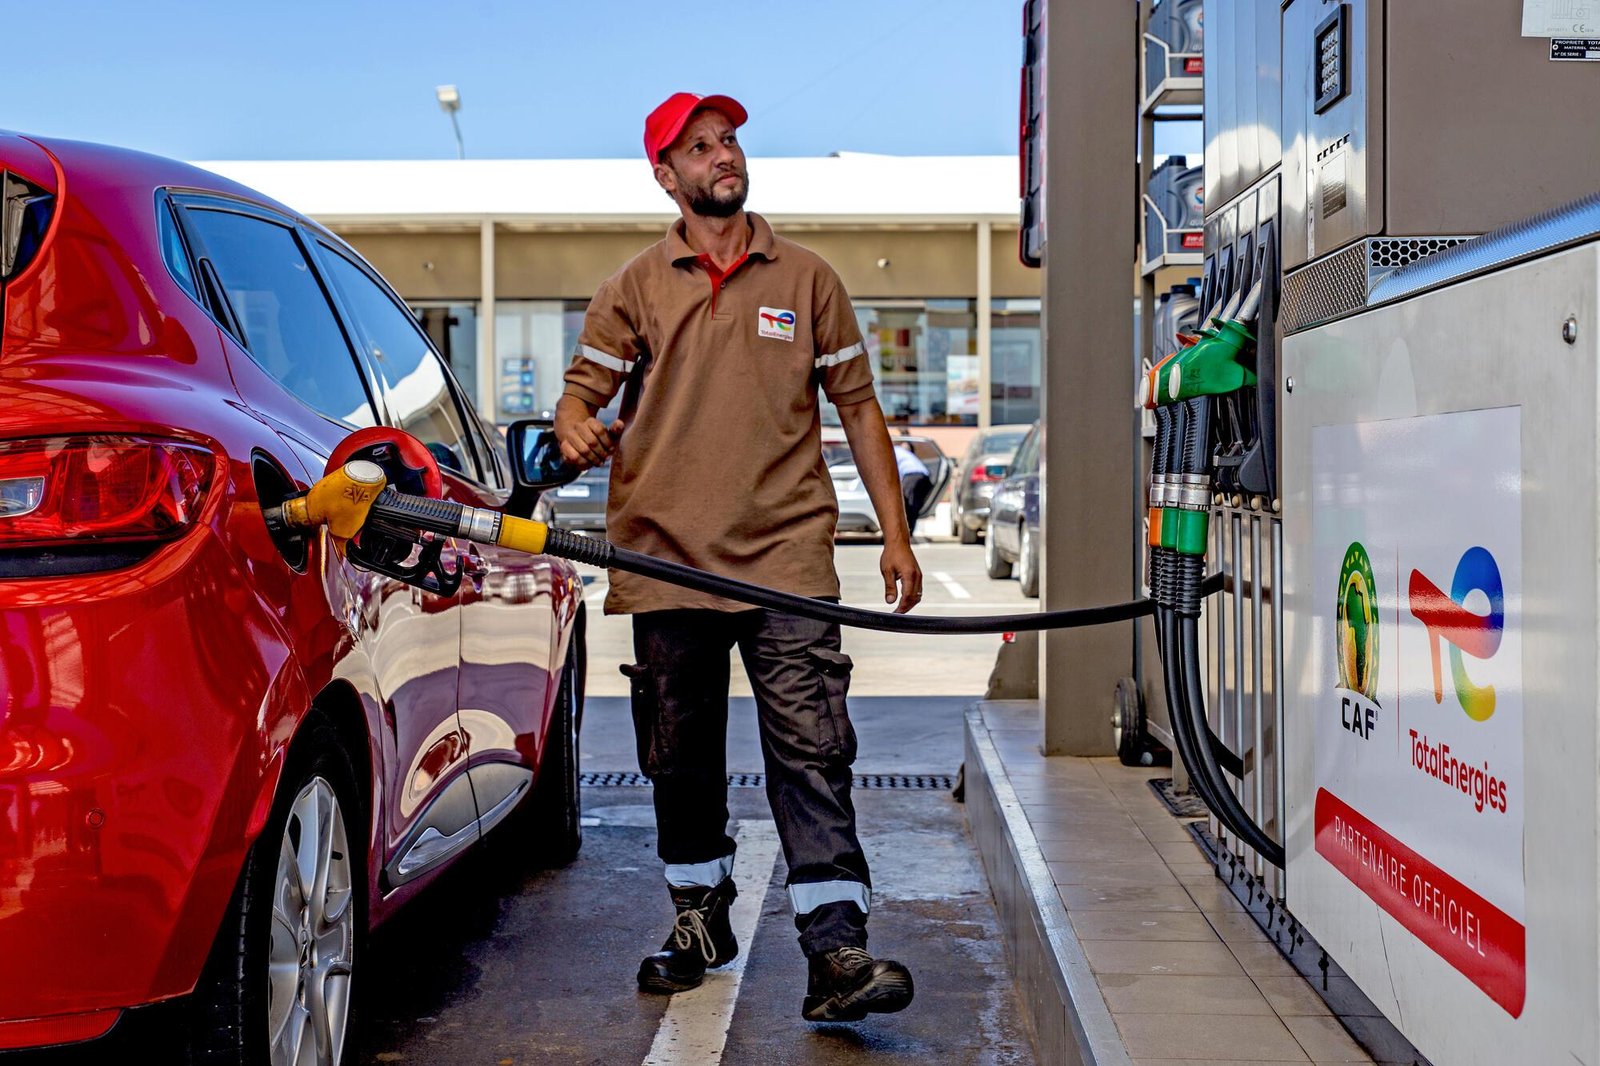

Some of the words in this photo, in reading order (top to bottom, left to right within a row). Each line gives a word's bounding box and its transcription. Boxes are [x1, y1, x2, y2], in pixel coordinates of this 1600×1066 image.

[1342, 697, 1374, 740] CAF
[1409, 728, 1507, 814] TotalEnergies
[1335, 815, 1407, 897] PARTENAIRE
[1413, 874, 1486, 957] OFFICIEL
